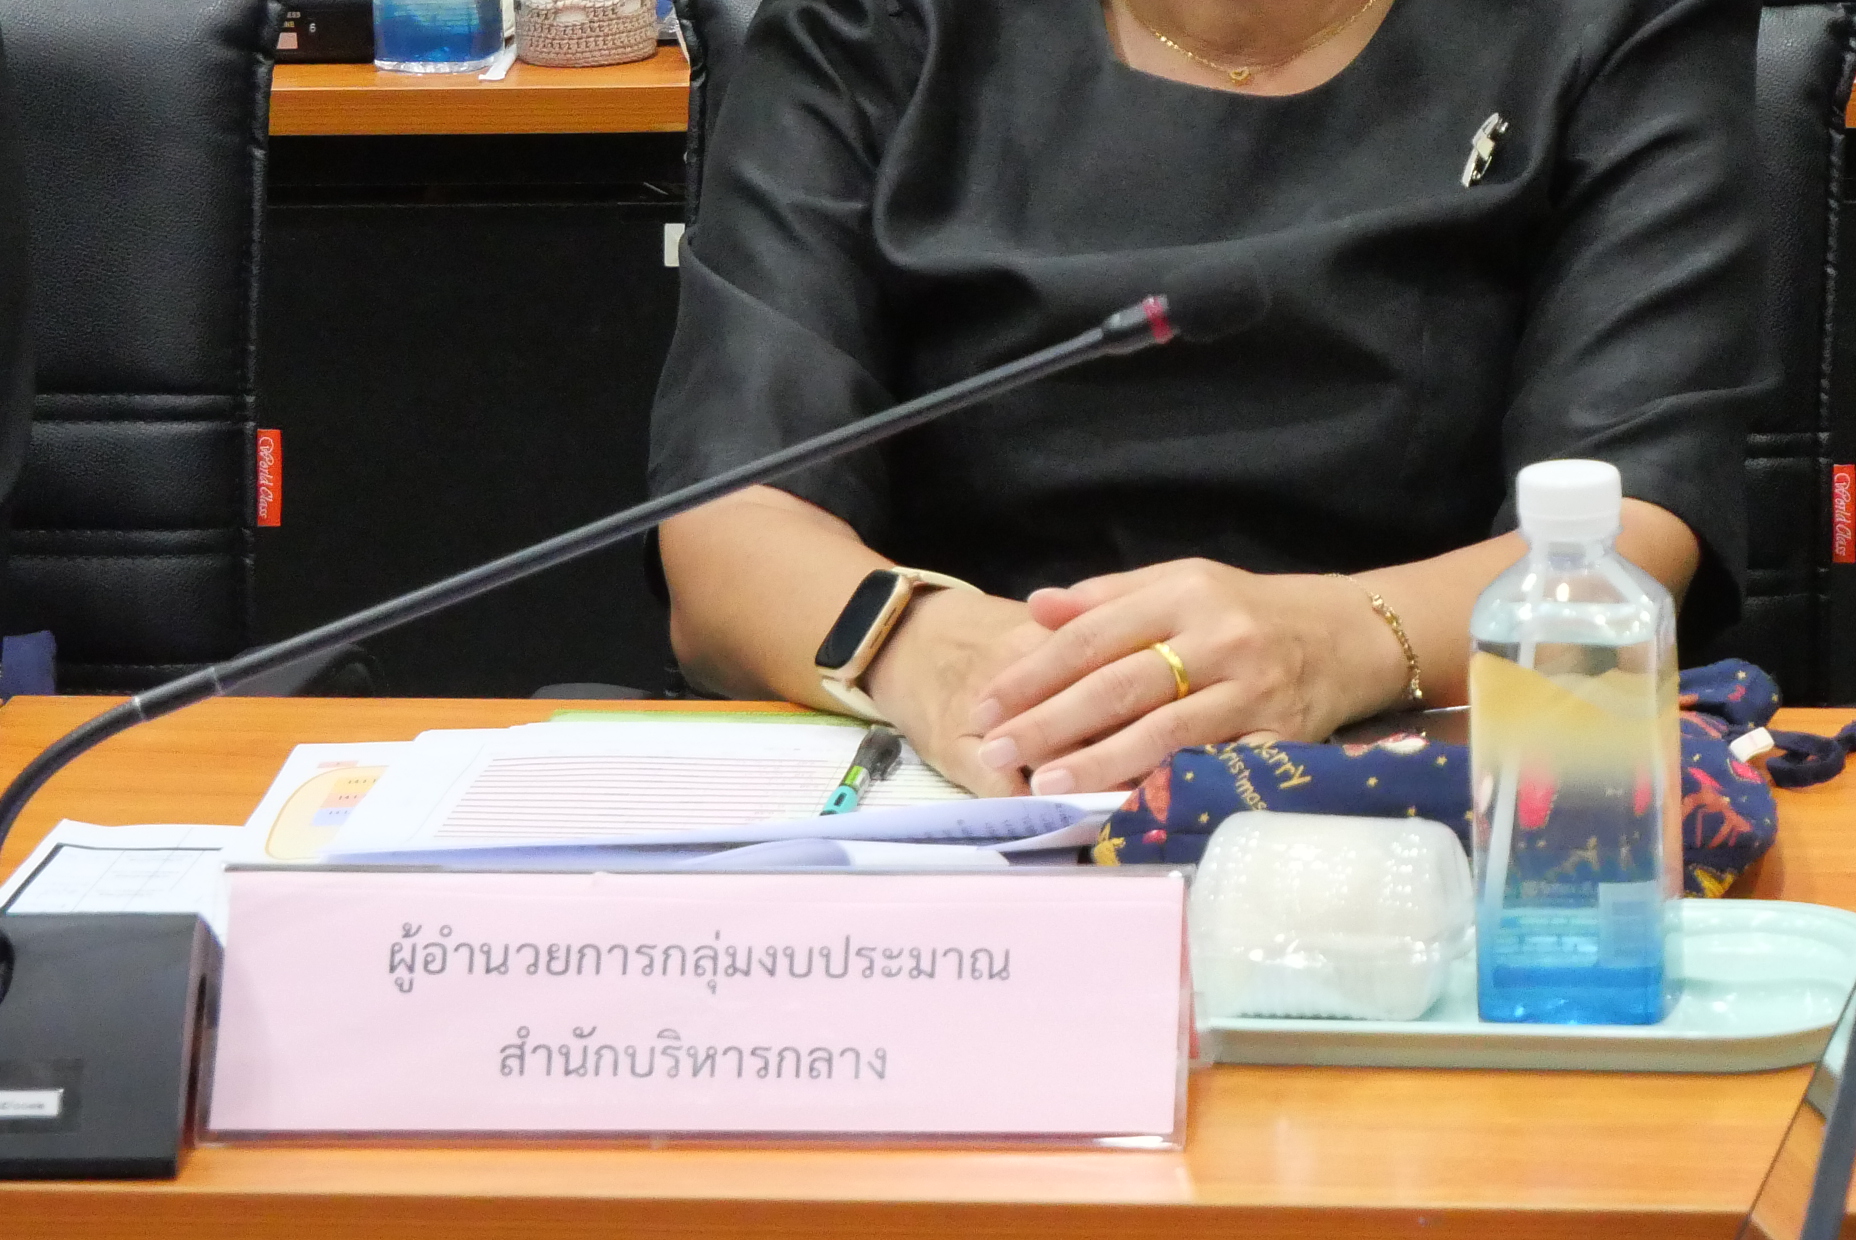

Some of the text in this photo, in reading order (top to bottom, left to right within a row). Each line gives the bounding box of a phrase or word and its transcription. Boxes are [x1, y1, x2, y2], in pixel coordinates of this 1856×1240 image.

[259, 436, 275, 519] World Class
[1834, 472, 1852, 557] World Class
[387, 921, 1012, 995] ผู้อำนวยการกลุ่มงบประมาณ
[499, 1025, 888, 1080] สำนักบริหารกลาง
